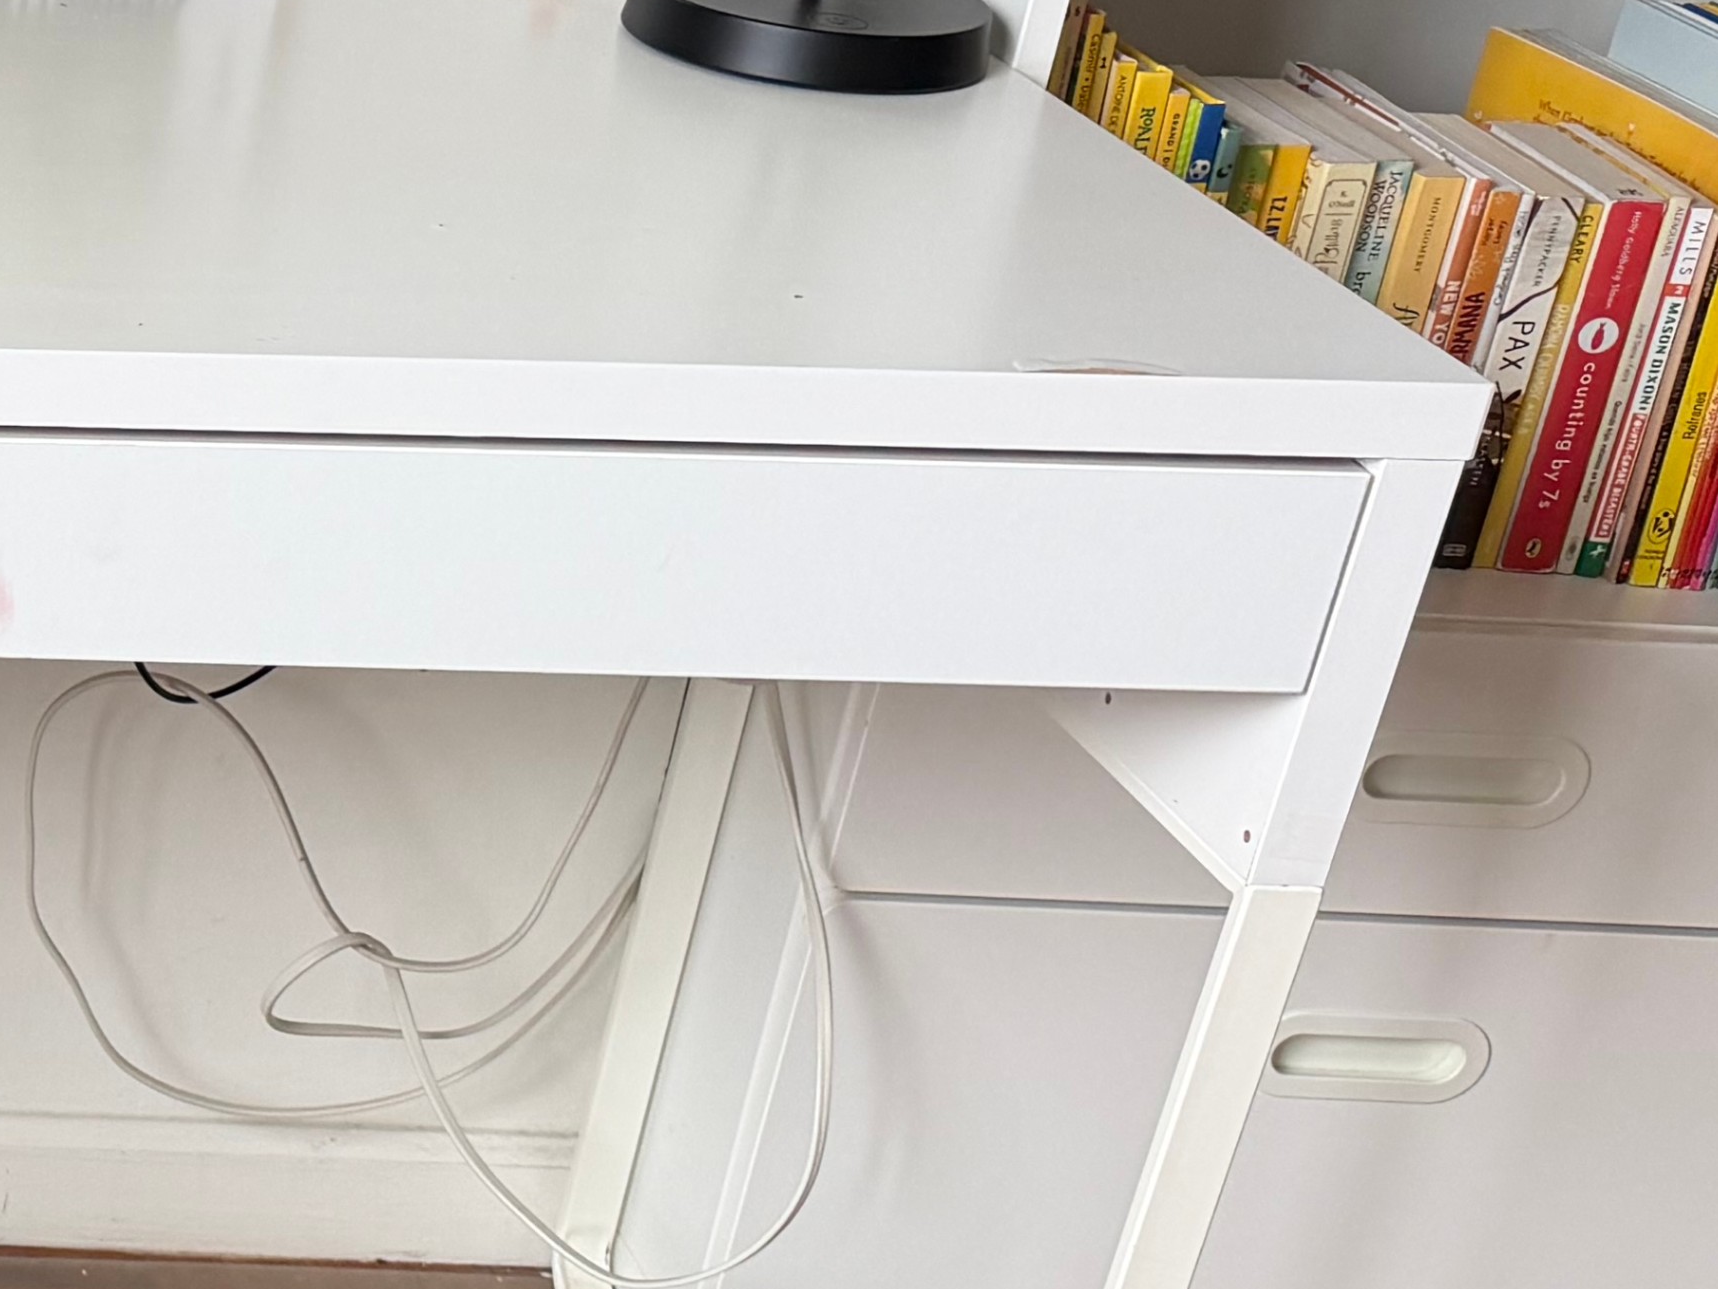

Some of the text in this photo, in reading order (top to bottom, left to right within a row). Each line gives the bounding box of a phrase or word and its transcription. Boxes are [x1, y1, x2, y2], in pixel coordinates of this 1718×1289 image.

[1355, 179, 1386, 253] WOODSON
[1368, 170, 1404, 262] JACQUELINE
[1413, 197, 1441, 273] MONTGOMERY
[1569, 215, 1594, 264] CLEARY
[1661, 207, 1686, 257] ALFAGUARA
[1679, 220, 1706, 276] MILLS
[1532, 215, 1561, 288] PENNYPACKER
[1432, 280, 1461, 344] NEW YO
[1654, 302, 1682, 355] MASON
[1499, 320, 1536, 370] PAX
[1538, 362, 1596, 510] counting by 7s
